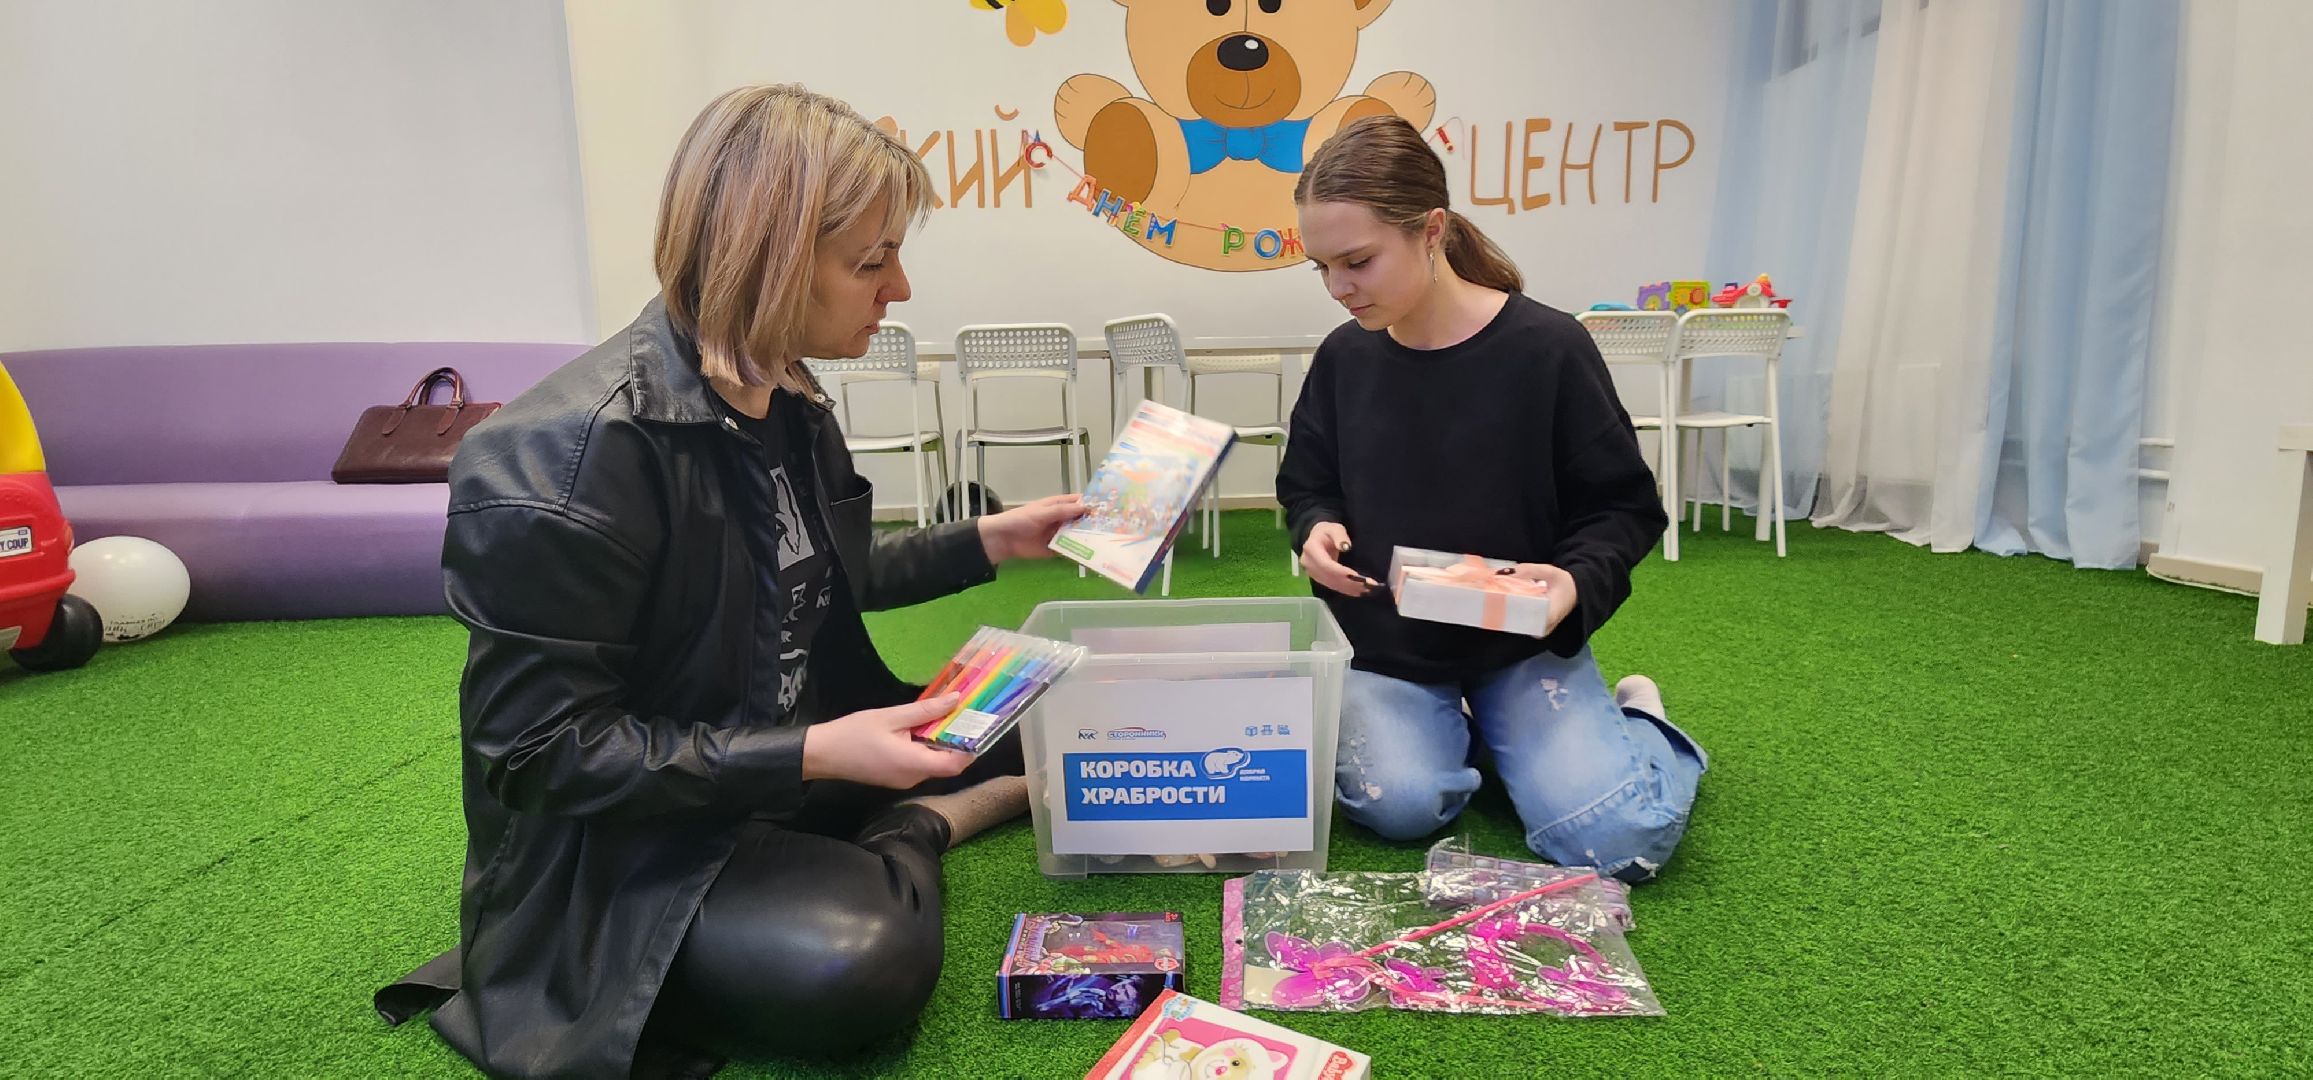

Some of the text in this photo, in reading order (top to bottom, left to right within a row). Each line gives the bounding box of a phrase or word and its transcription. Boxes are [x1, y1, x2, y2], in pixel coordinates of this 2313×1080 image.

[873, 104, 1696, 215] КИЙ ЦЕНТР
[1025, 140, 1053, 168] С
[1080, 760, 1196, 779] КОРОБКА
[1081, 786, 1225, 805] ХРАБРОСТИ
